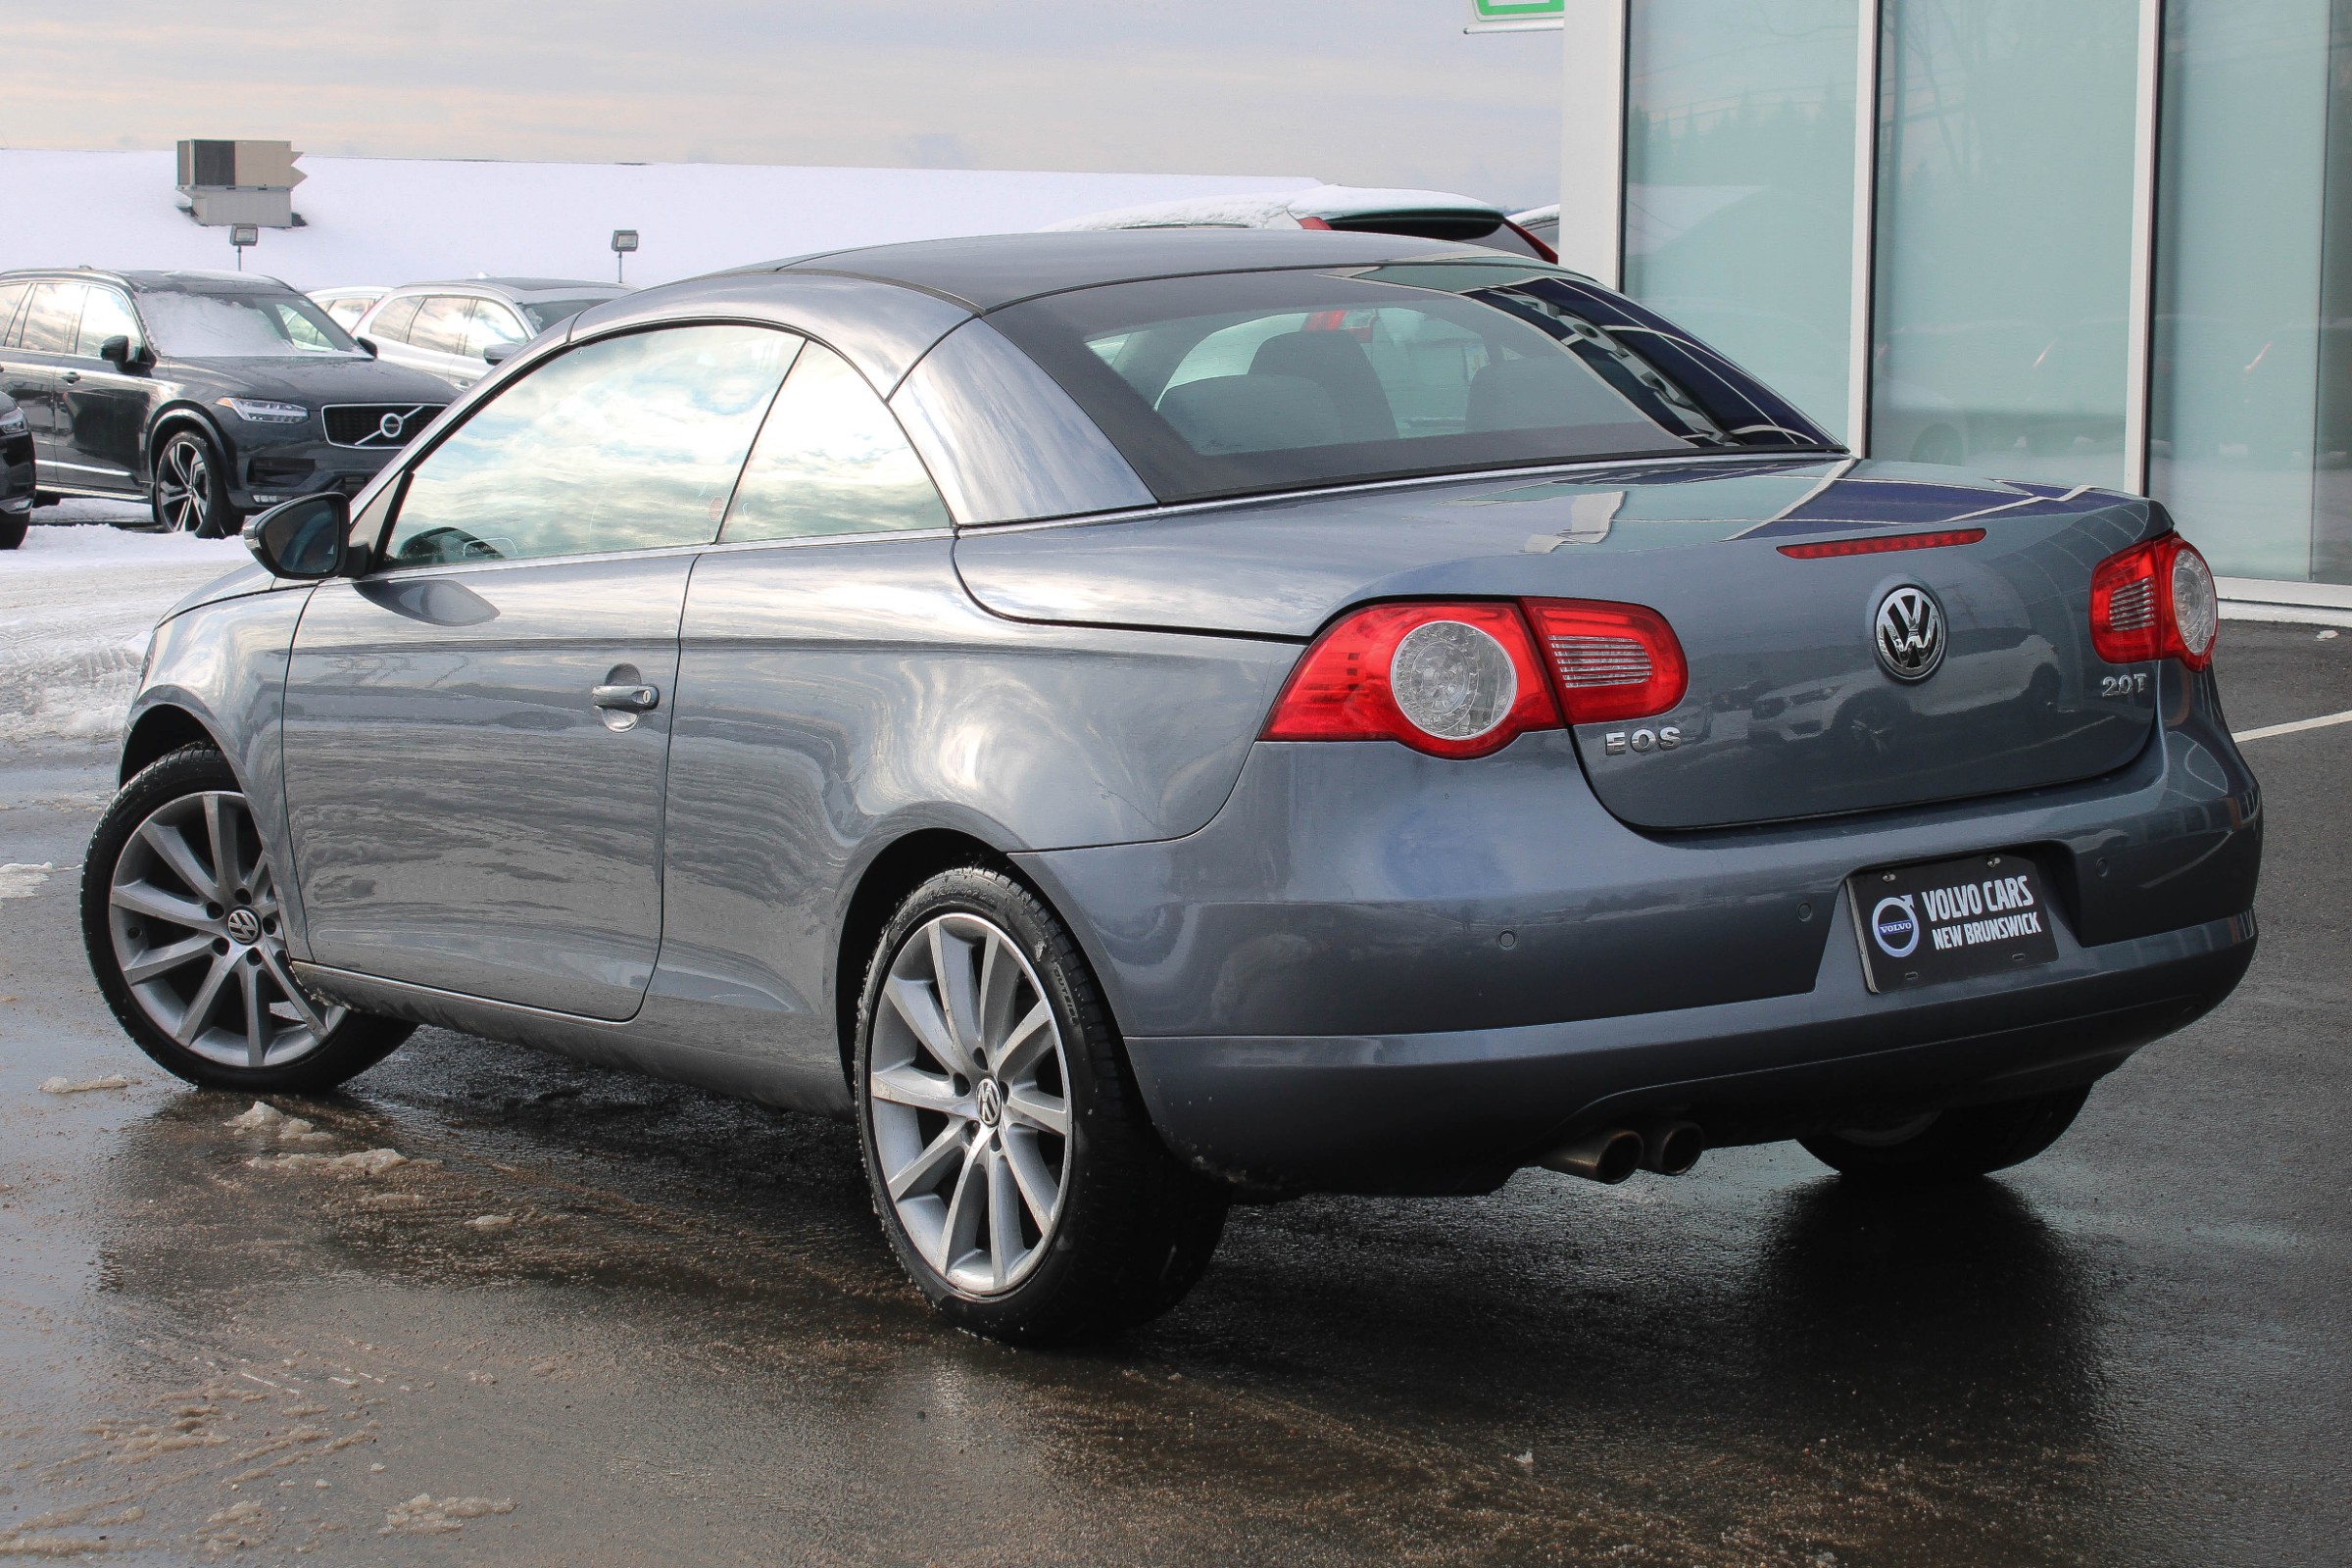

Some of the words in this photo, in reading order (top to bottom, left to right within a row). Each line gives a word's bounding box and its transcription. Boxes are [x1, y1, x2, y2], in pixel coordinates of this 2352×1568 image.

[1605, 726, 1682, 756] EOS
[1922, 883, 1983, 922] VOLVO
[1983, 875, 2034, 912] CARS
[1879, 921, 1912, 933] VOLVO
[1932, 922, 1963, 951] NEW
[1964, 911, 2042, 945] BRUNSWICK
